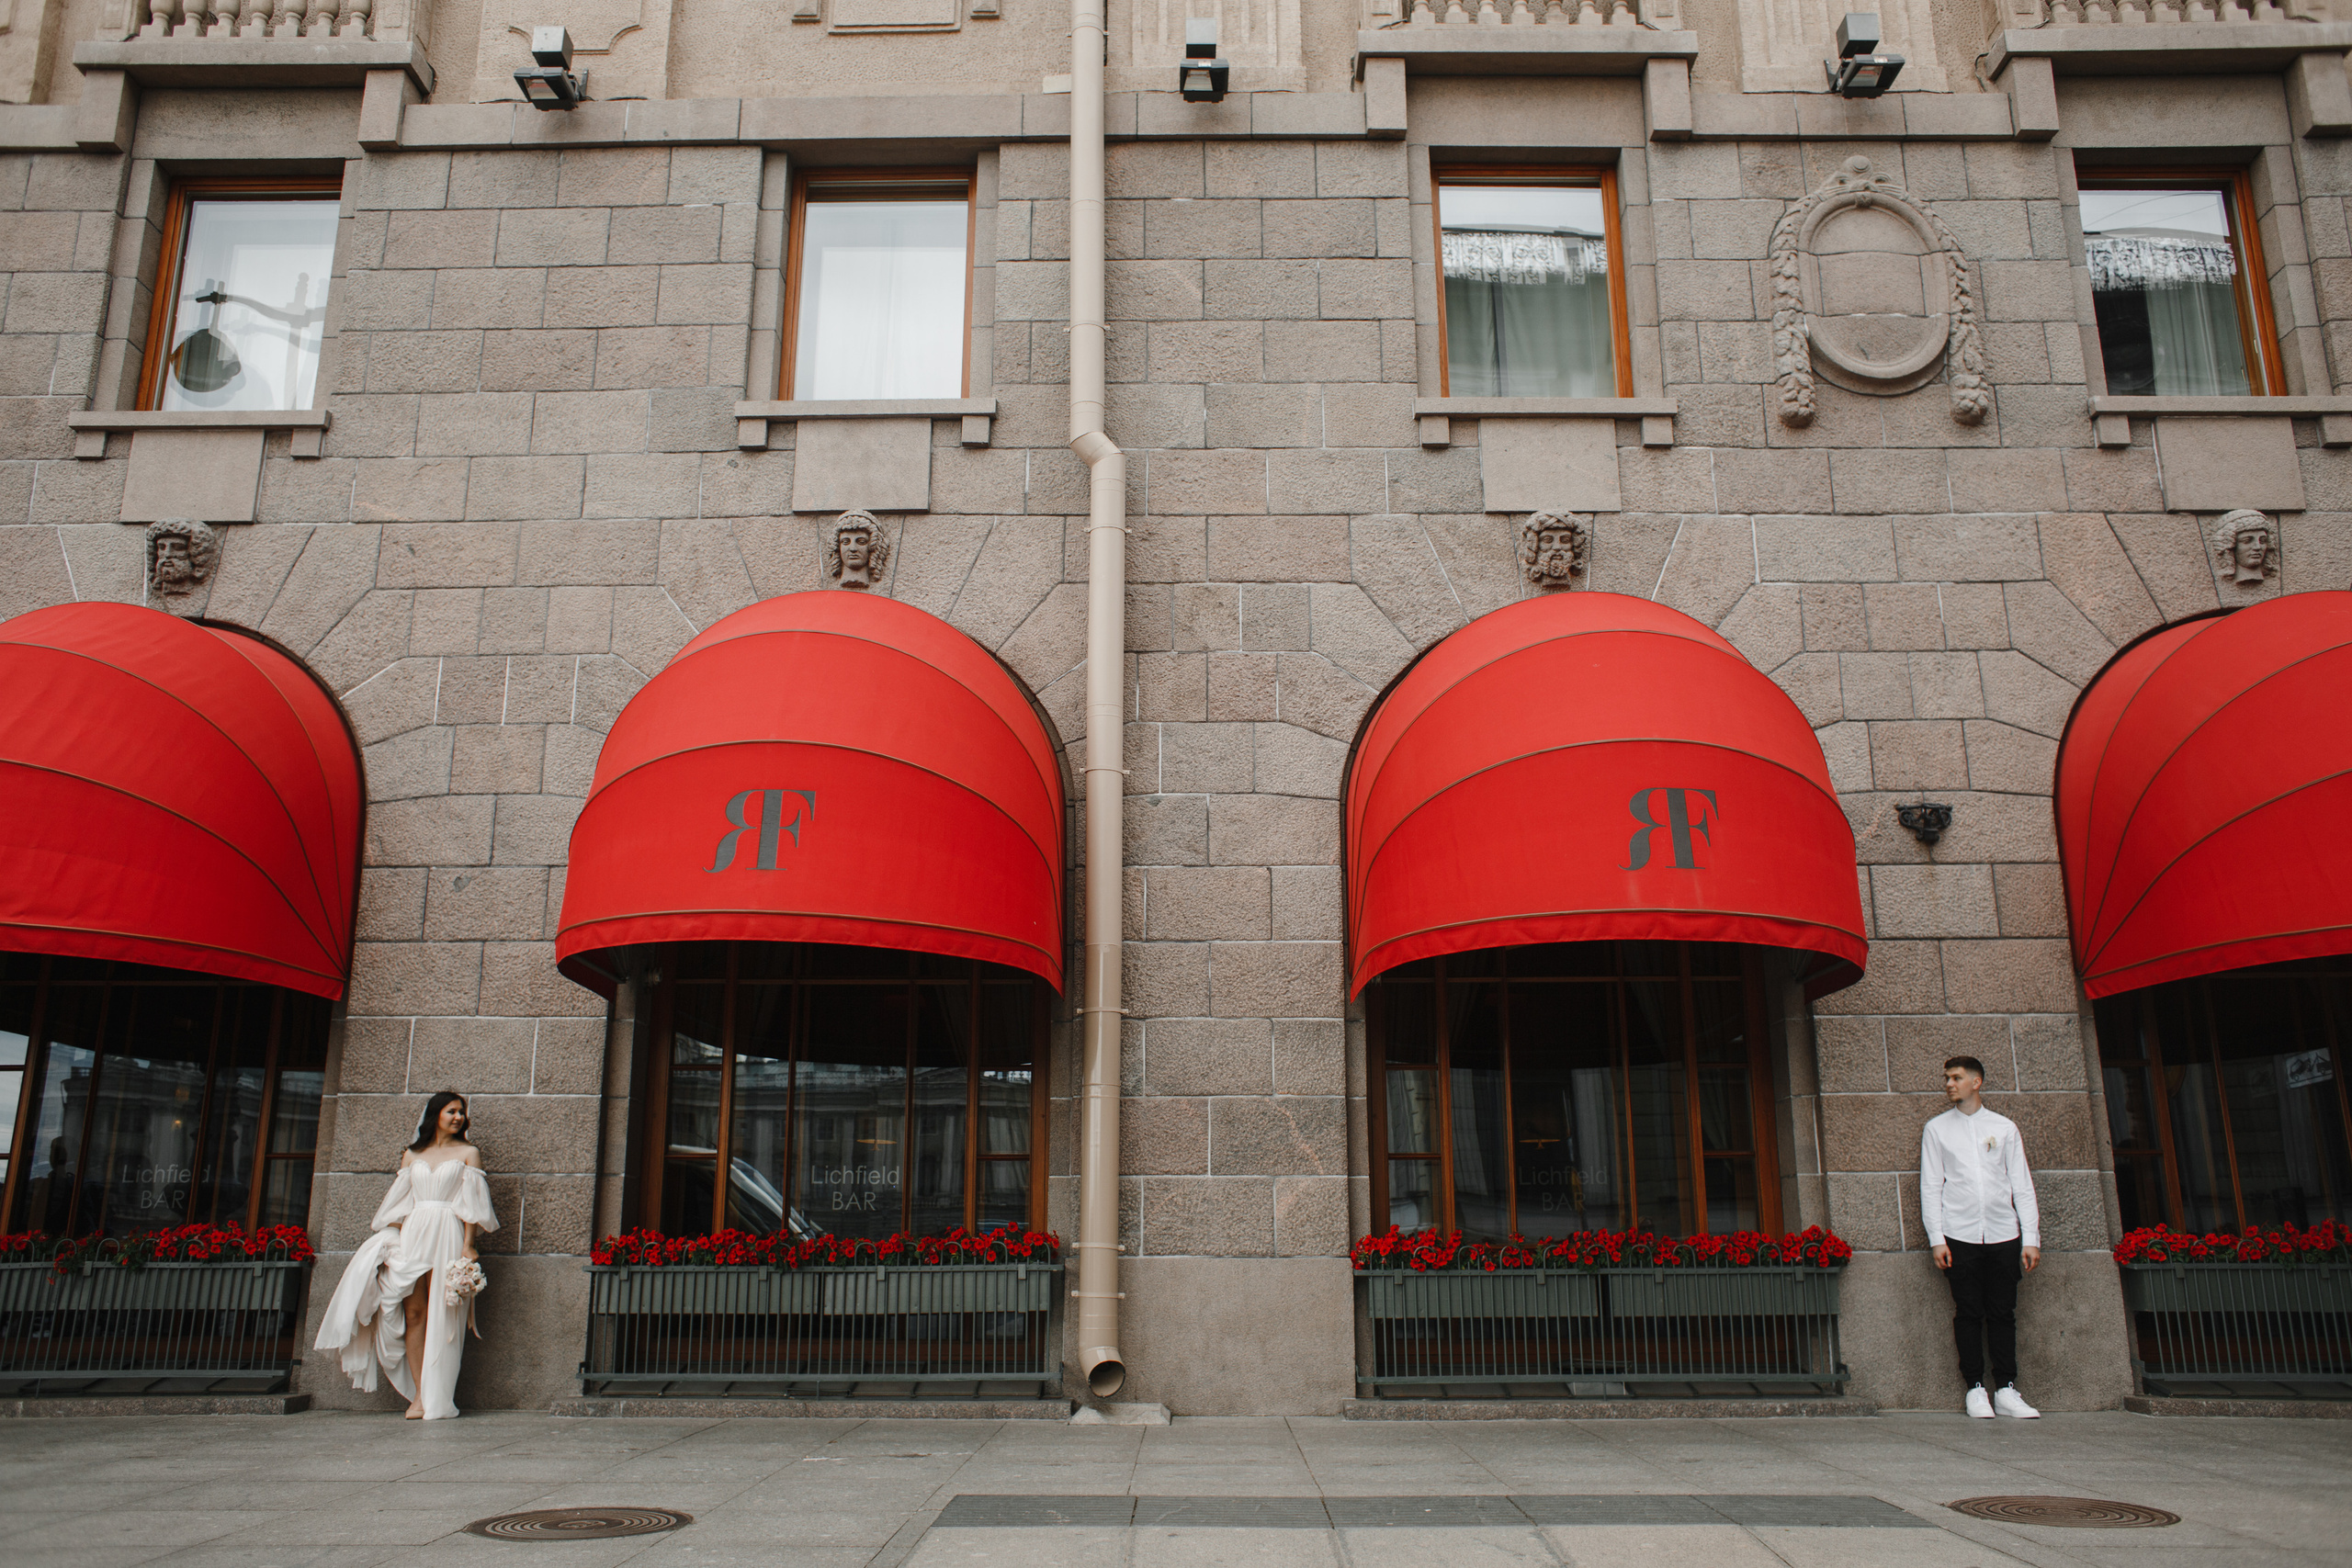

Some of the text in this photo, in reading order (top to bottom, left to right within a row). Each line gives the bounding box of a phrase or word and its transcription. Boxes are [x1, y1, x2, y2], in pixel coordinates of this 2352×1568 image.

[121, 1164, 211, 1183] Lichfied
[810, 1165, 900, 1185] Lichfield
[140, 1190, 186, 1210] BAR
[831, 1190, 876, 1212] BAR
[1542, 1191, 1588, 1212] BAR
